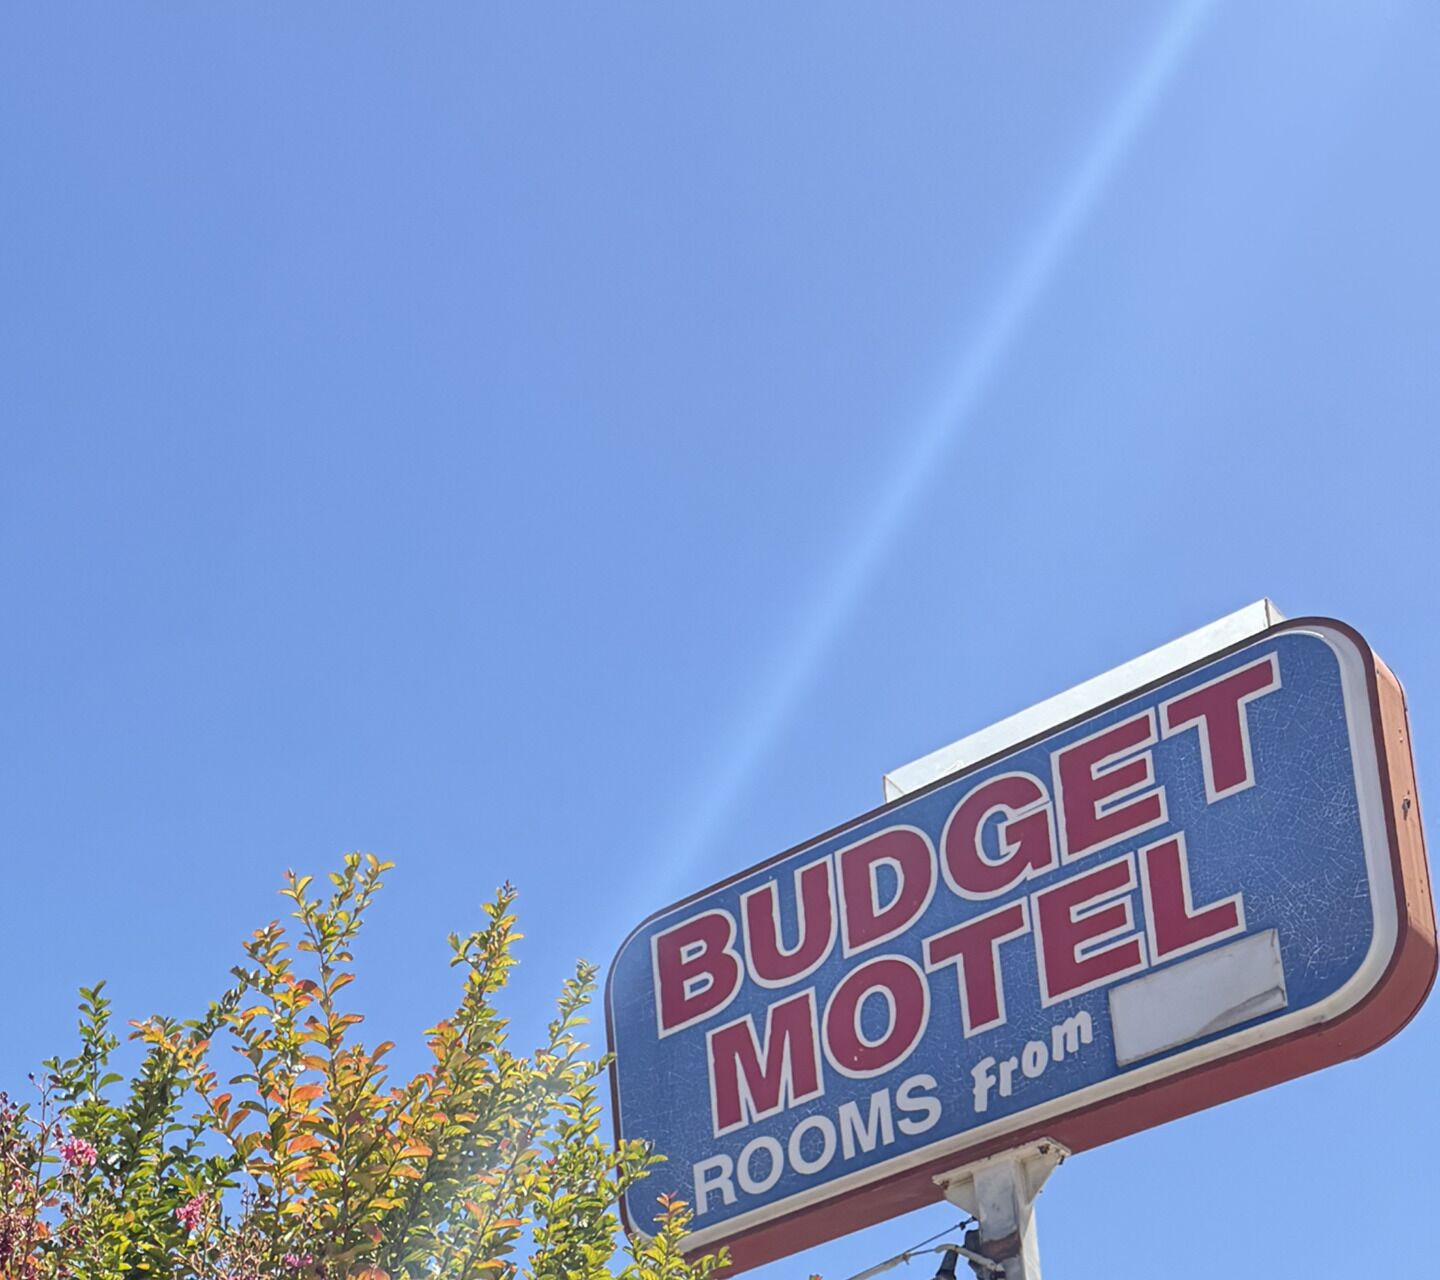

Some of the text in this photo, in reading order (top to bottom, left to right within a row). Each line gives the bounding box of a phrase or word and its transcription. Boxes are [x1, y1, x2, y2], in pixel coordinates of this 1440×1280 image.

[650, 651, 1282, 1039] BUDGET
[706, 832, 1247, 1138] MOTEL
[693, 1073, 942, 1215] ROOMS
